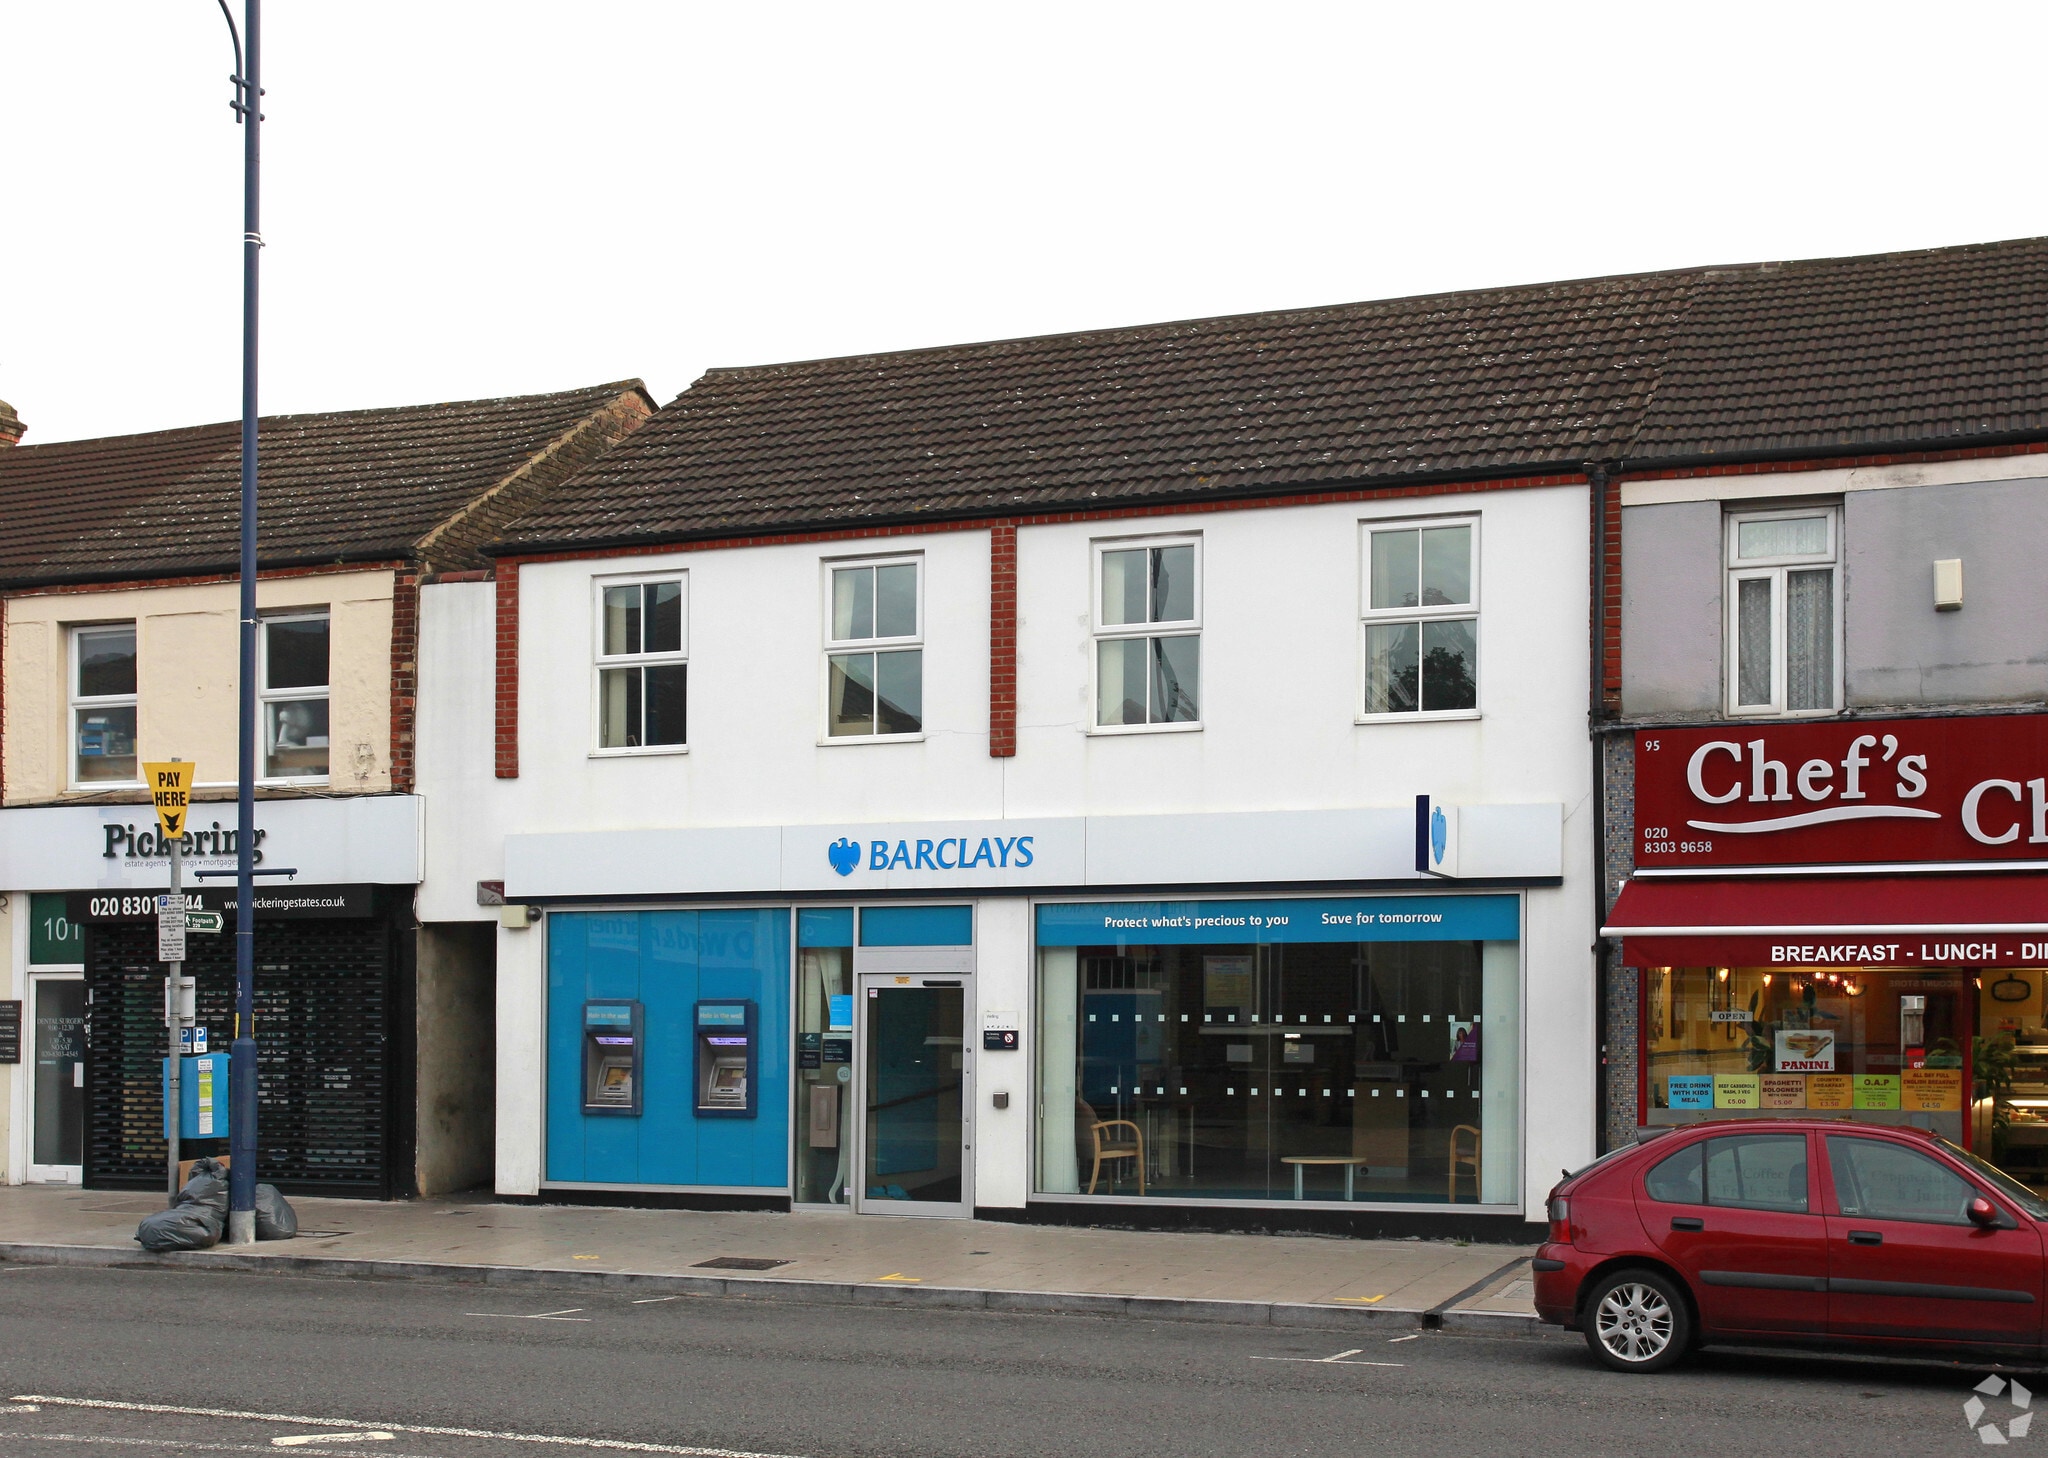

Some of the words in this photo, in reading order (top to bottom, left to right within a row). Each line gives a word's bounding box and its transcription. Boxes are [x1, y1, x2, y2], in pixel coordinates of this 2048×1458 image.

[1644, 740, 1660, 752] 95
[1687, 734, 1928, 804] Chef's
[158, 772, 180, 787] PAY
[155, 792, 187, 806] HERE
[1644, 827, 1668, 839] 020
[869, 836, 1034, 871] BARCLAYS
[1644, 841, 1676, 854] 8303
[1680, 840, 1712, 853] 9658
[124, 860, 144, 868] estate
[145, 860, 166, 869] agents
[90, 898, 119, 916] 020
[122, 896, 158, 916] 8301
[1104, 916, 1148, 928] Protect
[1152, 916, 1191, 927] what's
[1194, 915, 1245, 929] precious
[1250, 916, 1262, 926] to
[1265, 916, 1289, 928] you
[1321, 913, 1352, 924] Save
[1356, 912, 1374, 925] for
[1379, 913, 1442, 923] tomorrow
[44, 917, 78, 941] 101
[1771, 944, 1899, 962] BREAKFAST
[1921, 944, 1996, 960] LUNCH
[197, 1028, 204, 1042] P
[1781, 1061, 1829, 1070] PANINI
